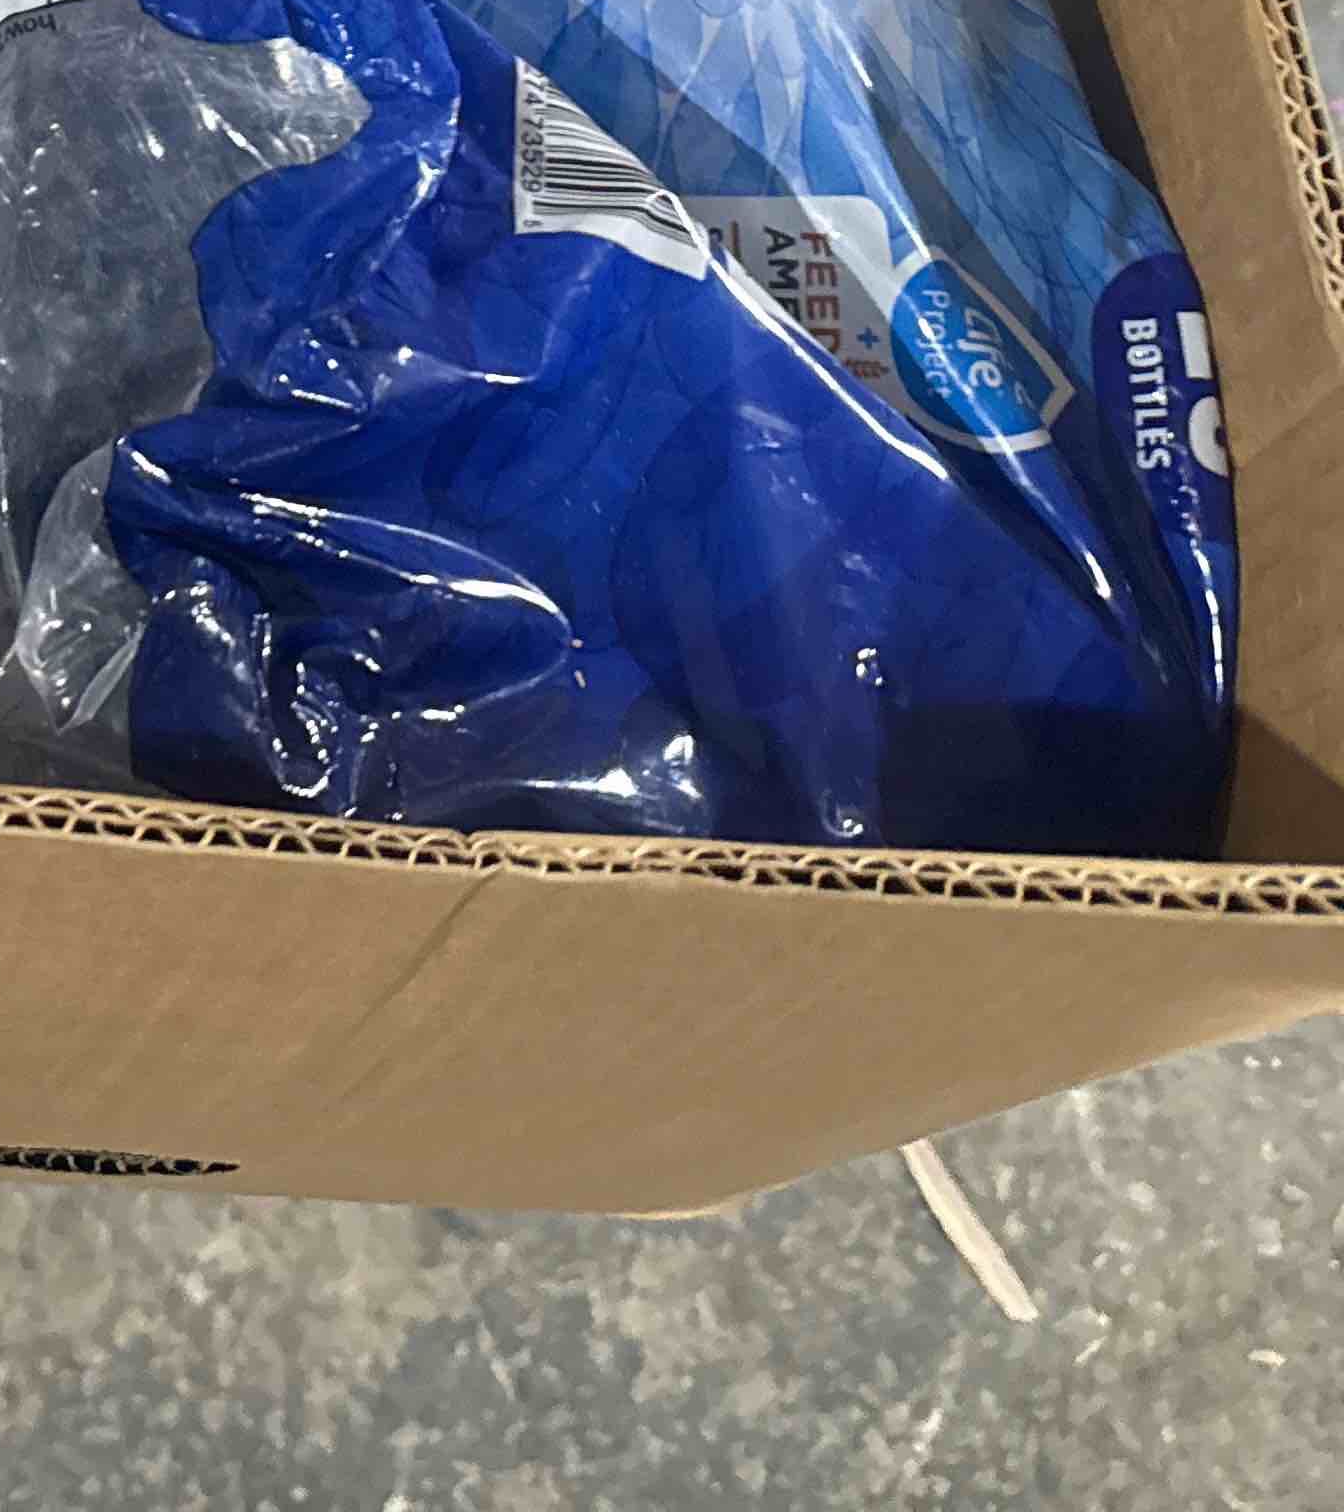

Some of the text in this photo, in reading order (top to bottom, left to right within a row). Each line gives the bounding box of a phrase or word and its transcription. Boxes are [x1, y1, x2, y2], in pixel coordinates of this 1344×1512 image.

[520, 117, 545, 194] 73529
[801, 231, 844, 355] FEED
[1121, 317, 1173, 470] BOTTLES
